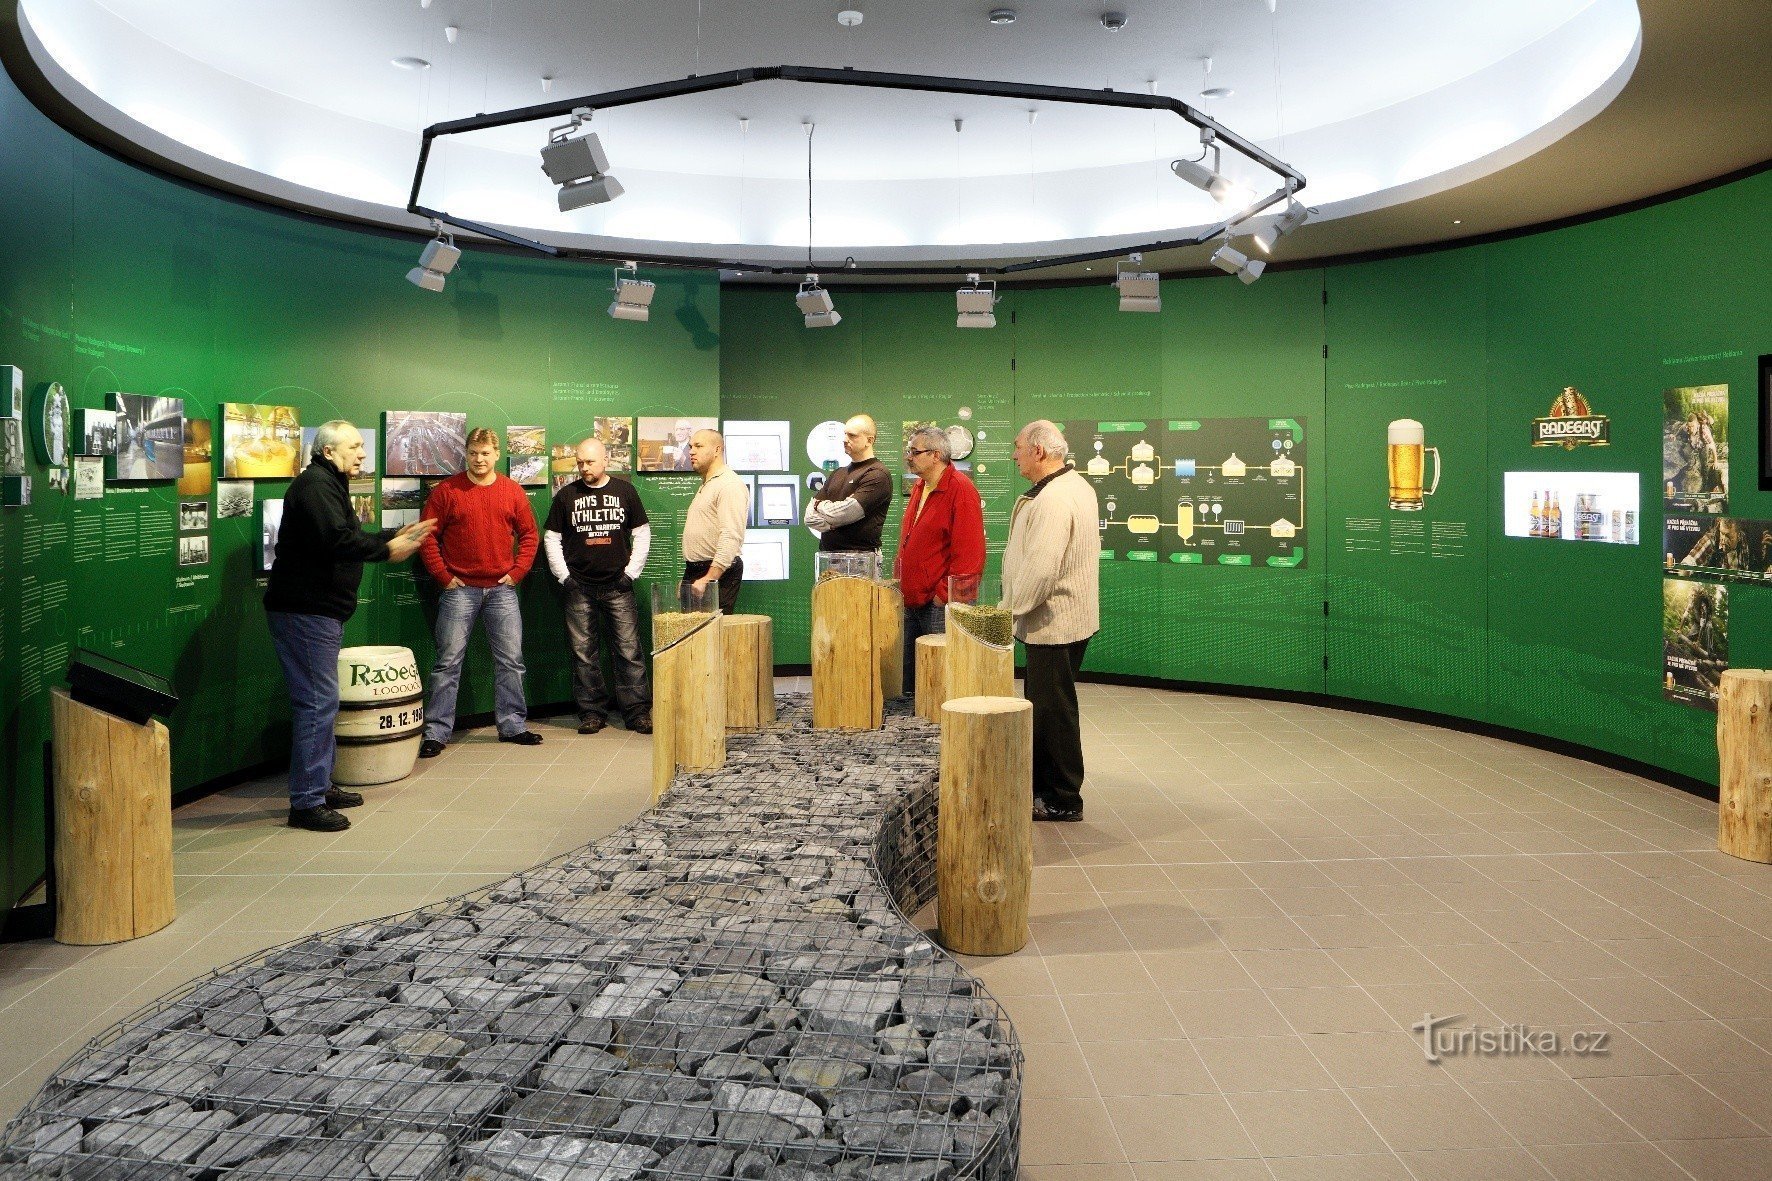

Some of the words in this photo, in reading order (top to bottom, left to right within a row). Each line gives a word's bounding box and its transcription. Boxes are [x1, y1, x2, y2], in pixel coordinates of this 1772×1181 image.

[1539, 420, 1602, 438] RADEGAST
[574, 495, 597, 512] PHYS
[603, 494, 620, 508] EDU
[571, 507, 625, 527] ATHLETICS
